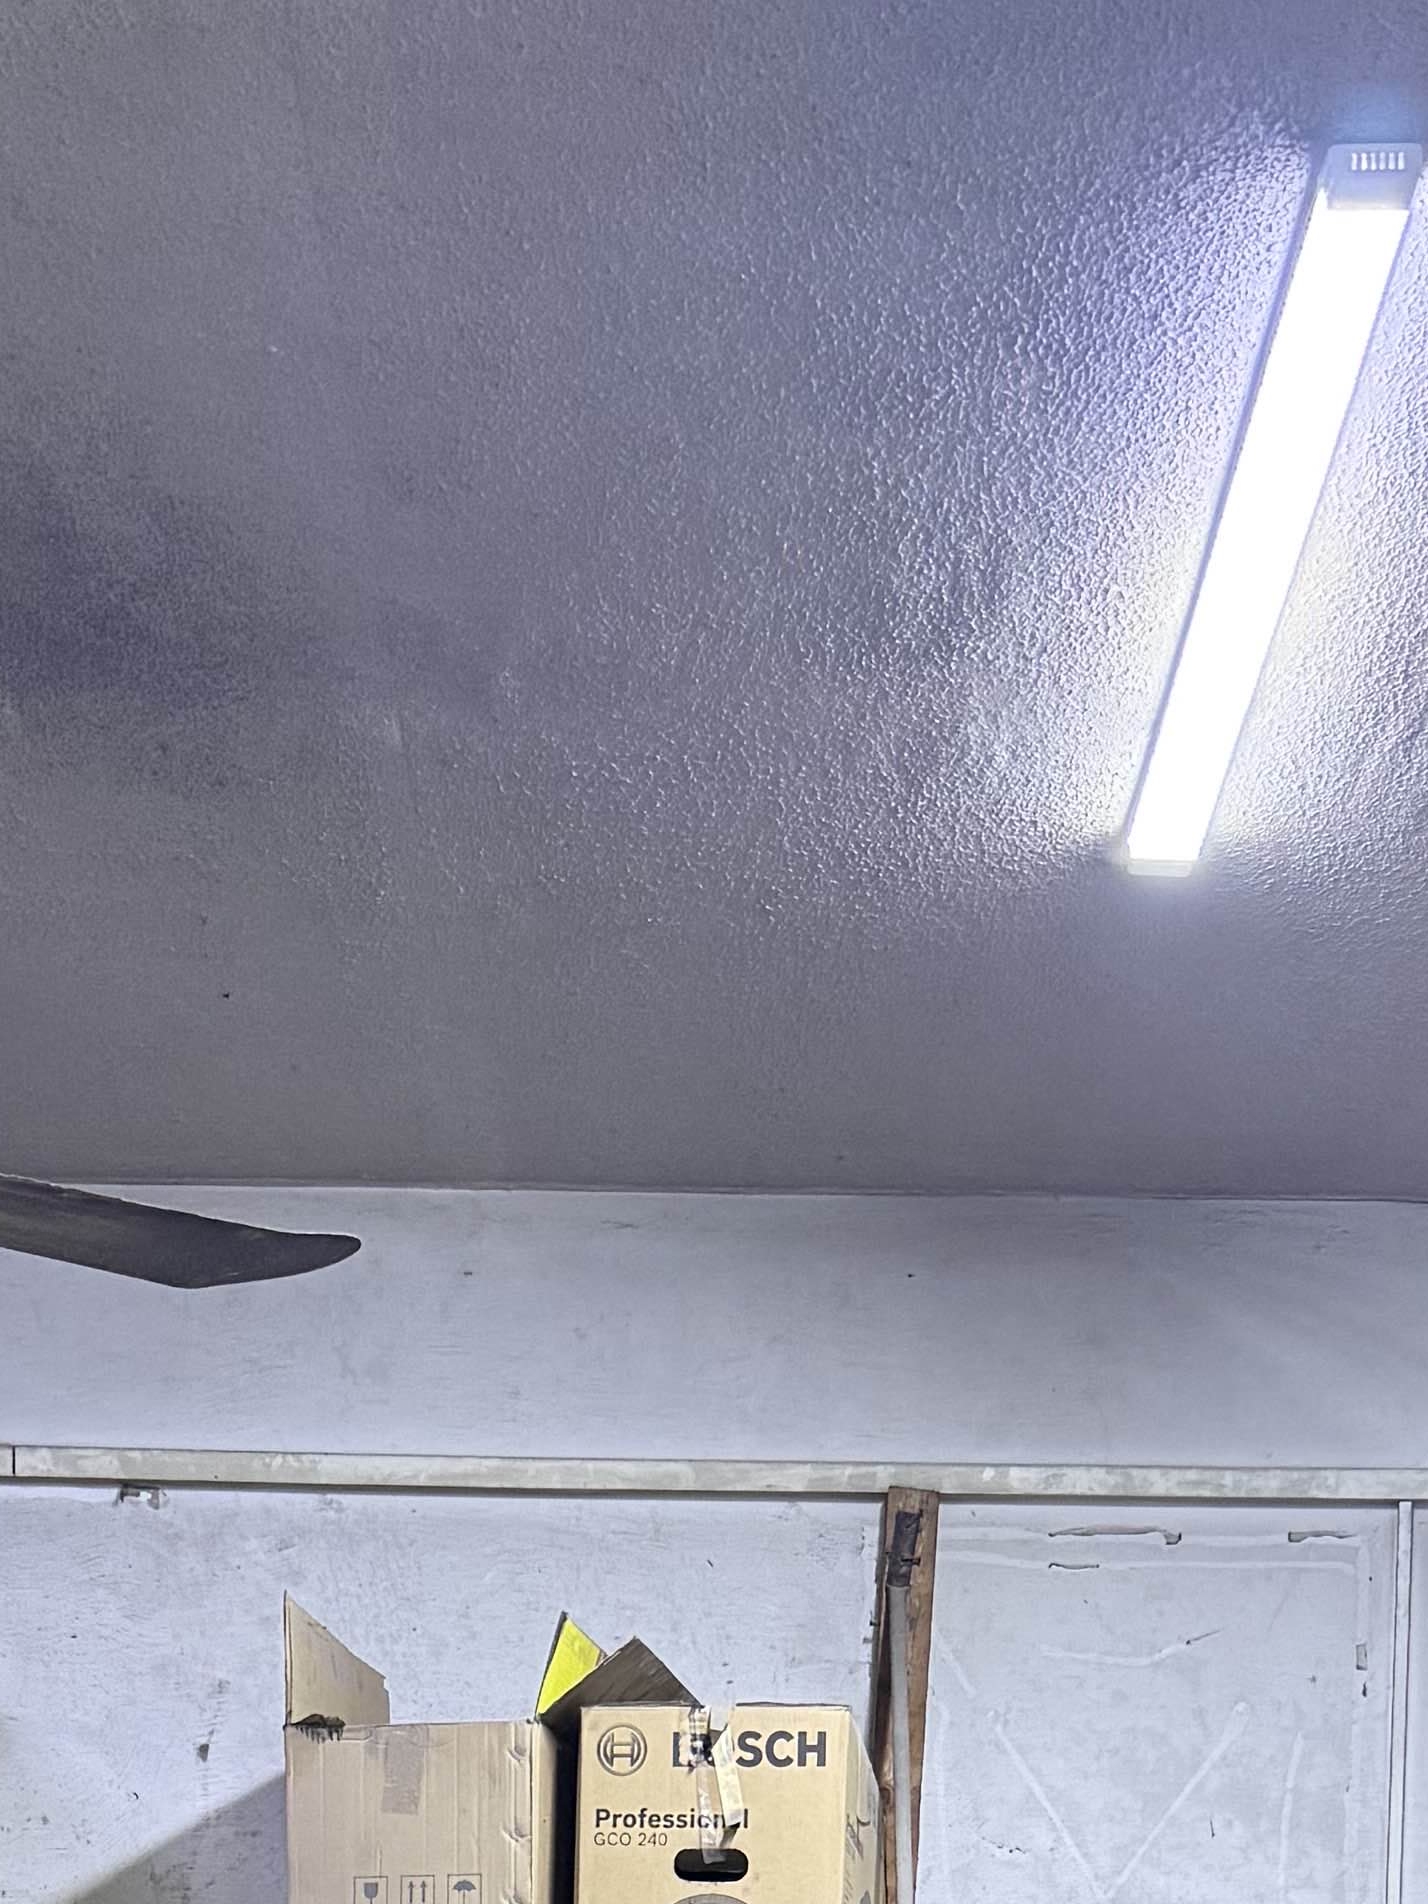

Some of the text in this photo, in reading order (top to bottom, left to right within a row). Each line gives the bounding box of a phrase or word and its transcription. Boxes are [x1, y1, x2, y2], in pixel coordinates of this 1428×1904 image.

[595, 1808, 749, 1829] Professionl
[594, 1832, 668, 1847] GCO 240
